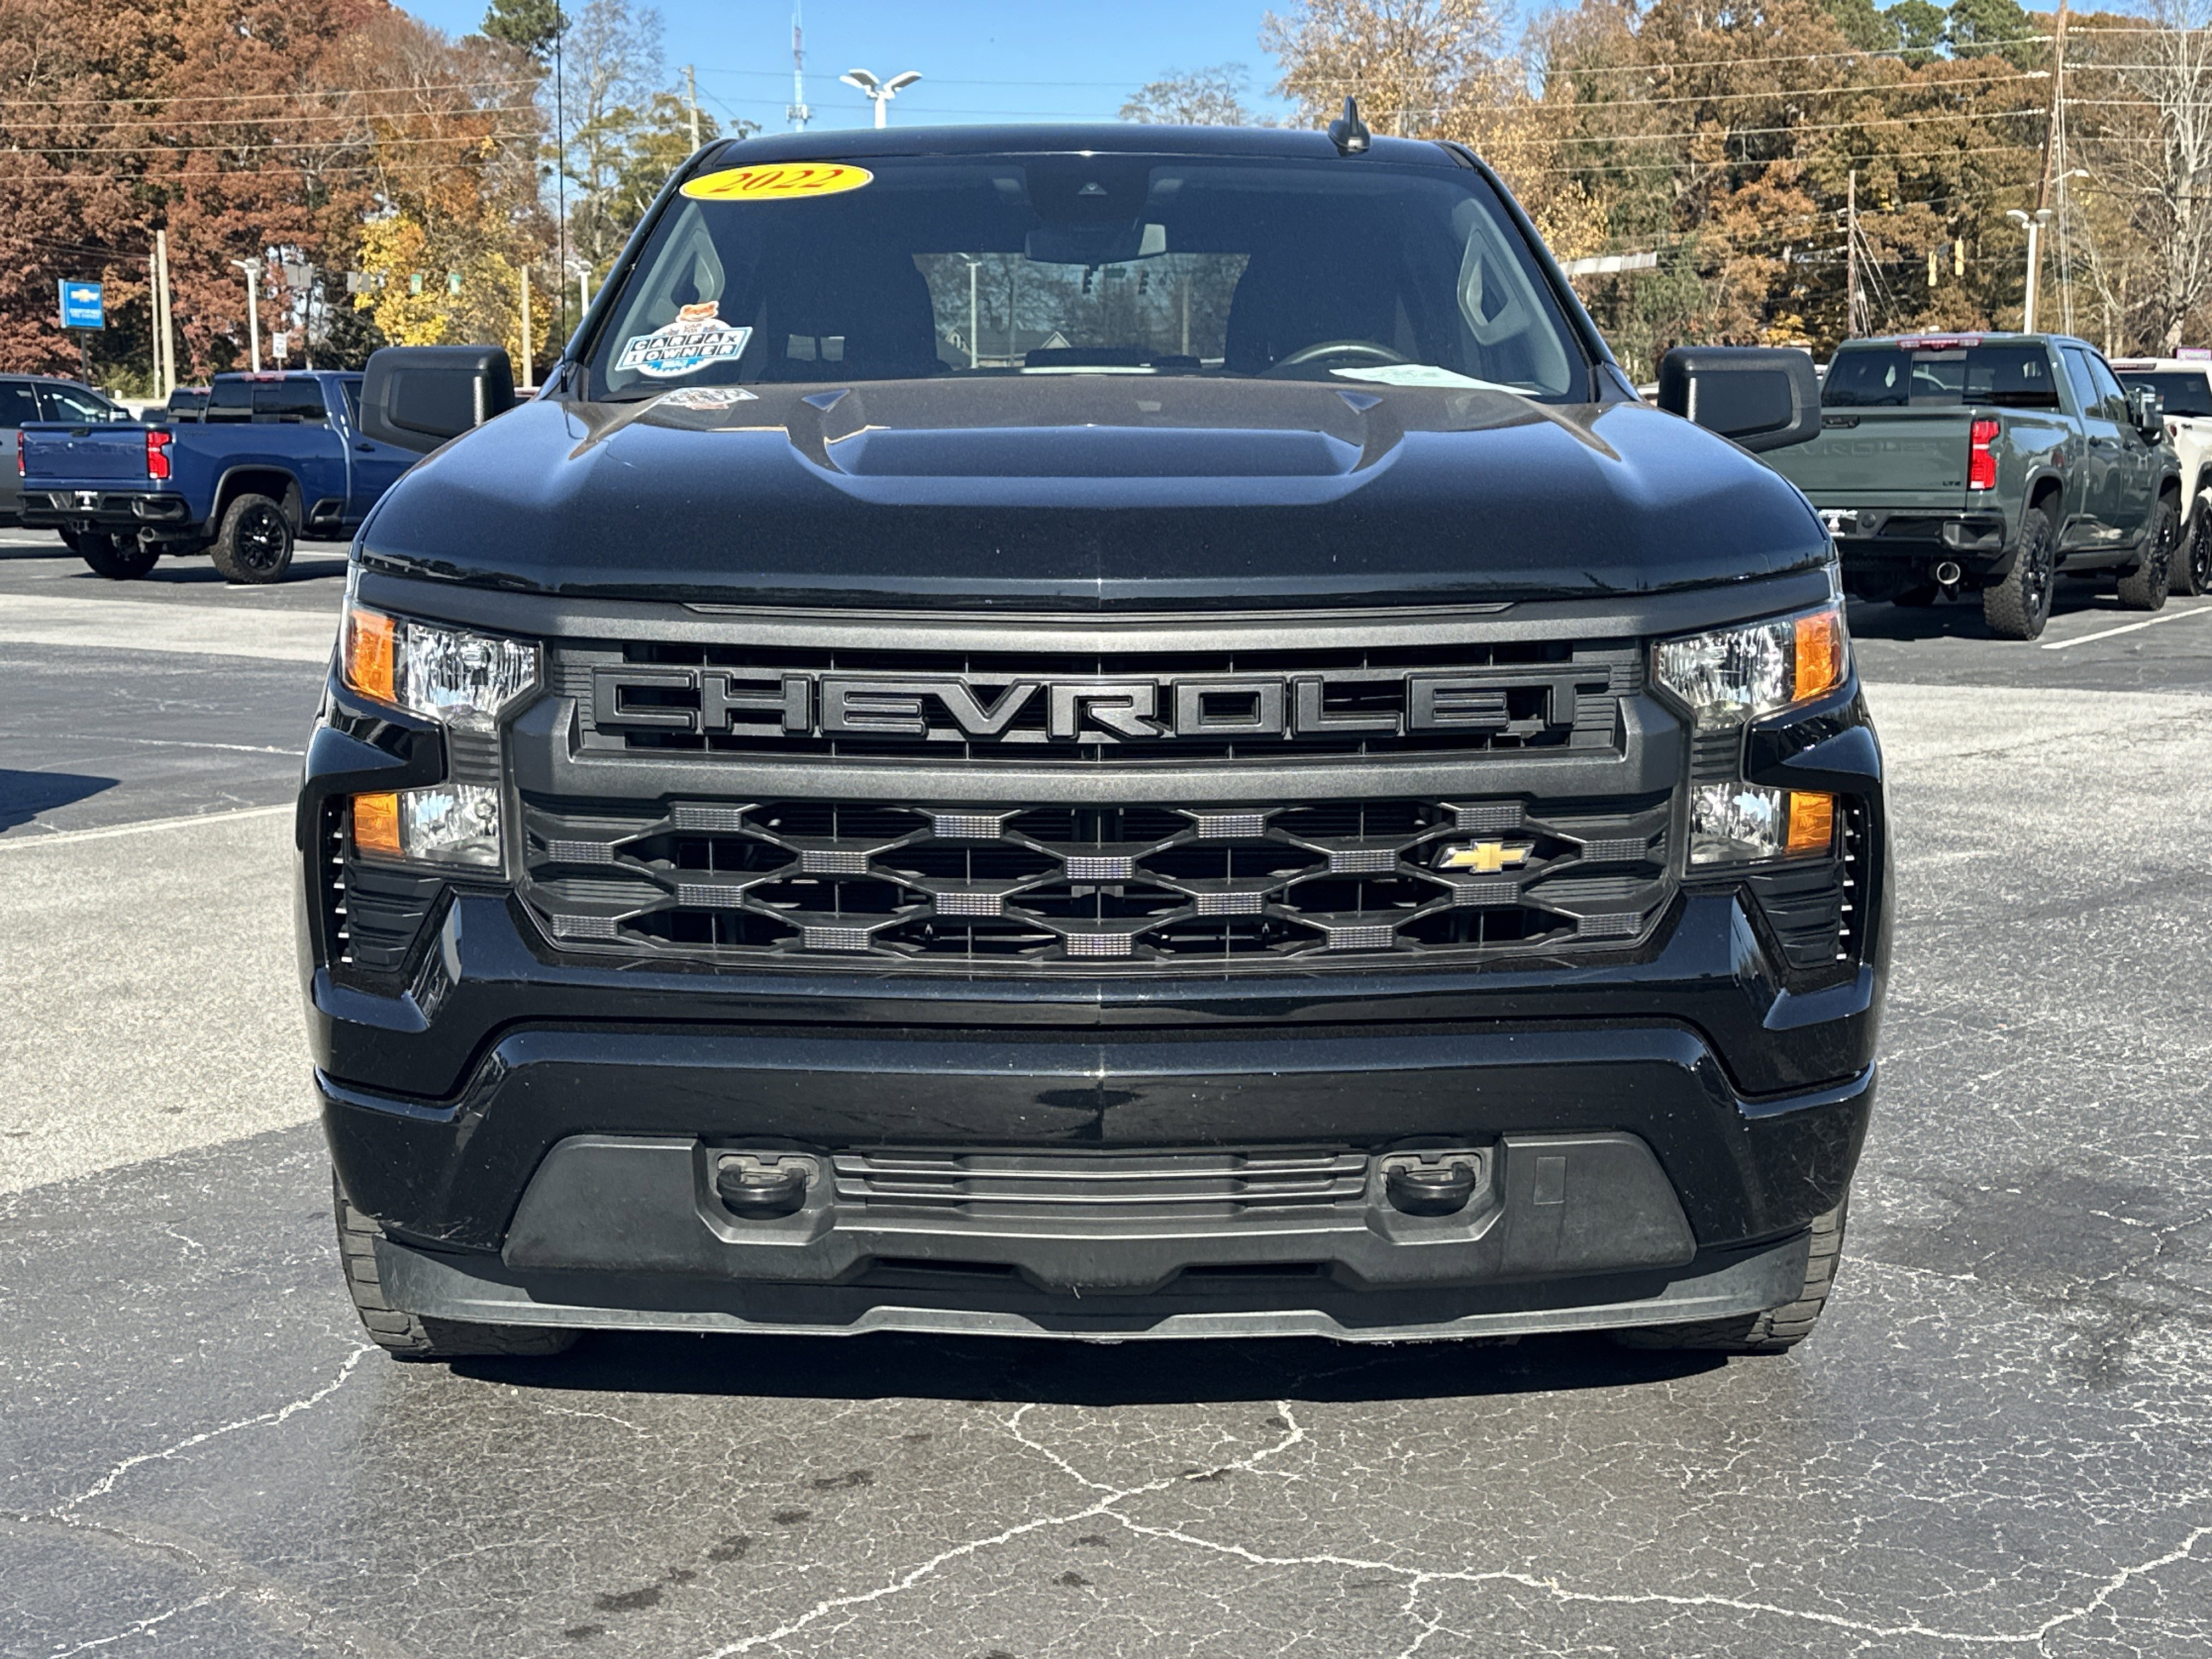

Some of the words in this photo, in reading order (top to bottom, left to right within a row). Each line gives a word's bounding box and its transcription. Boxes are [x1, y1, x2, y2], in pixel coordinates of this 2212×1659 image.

[708, 169, 844, 194] 2022
[631, 332, 737, 352] CARFAX
[592, 665, 1612, 741] CHEVROLET
